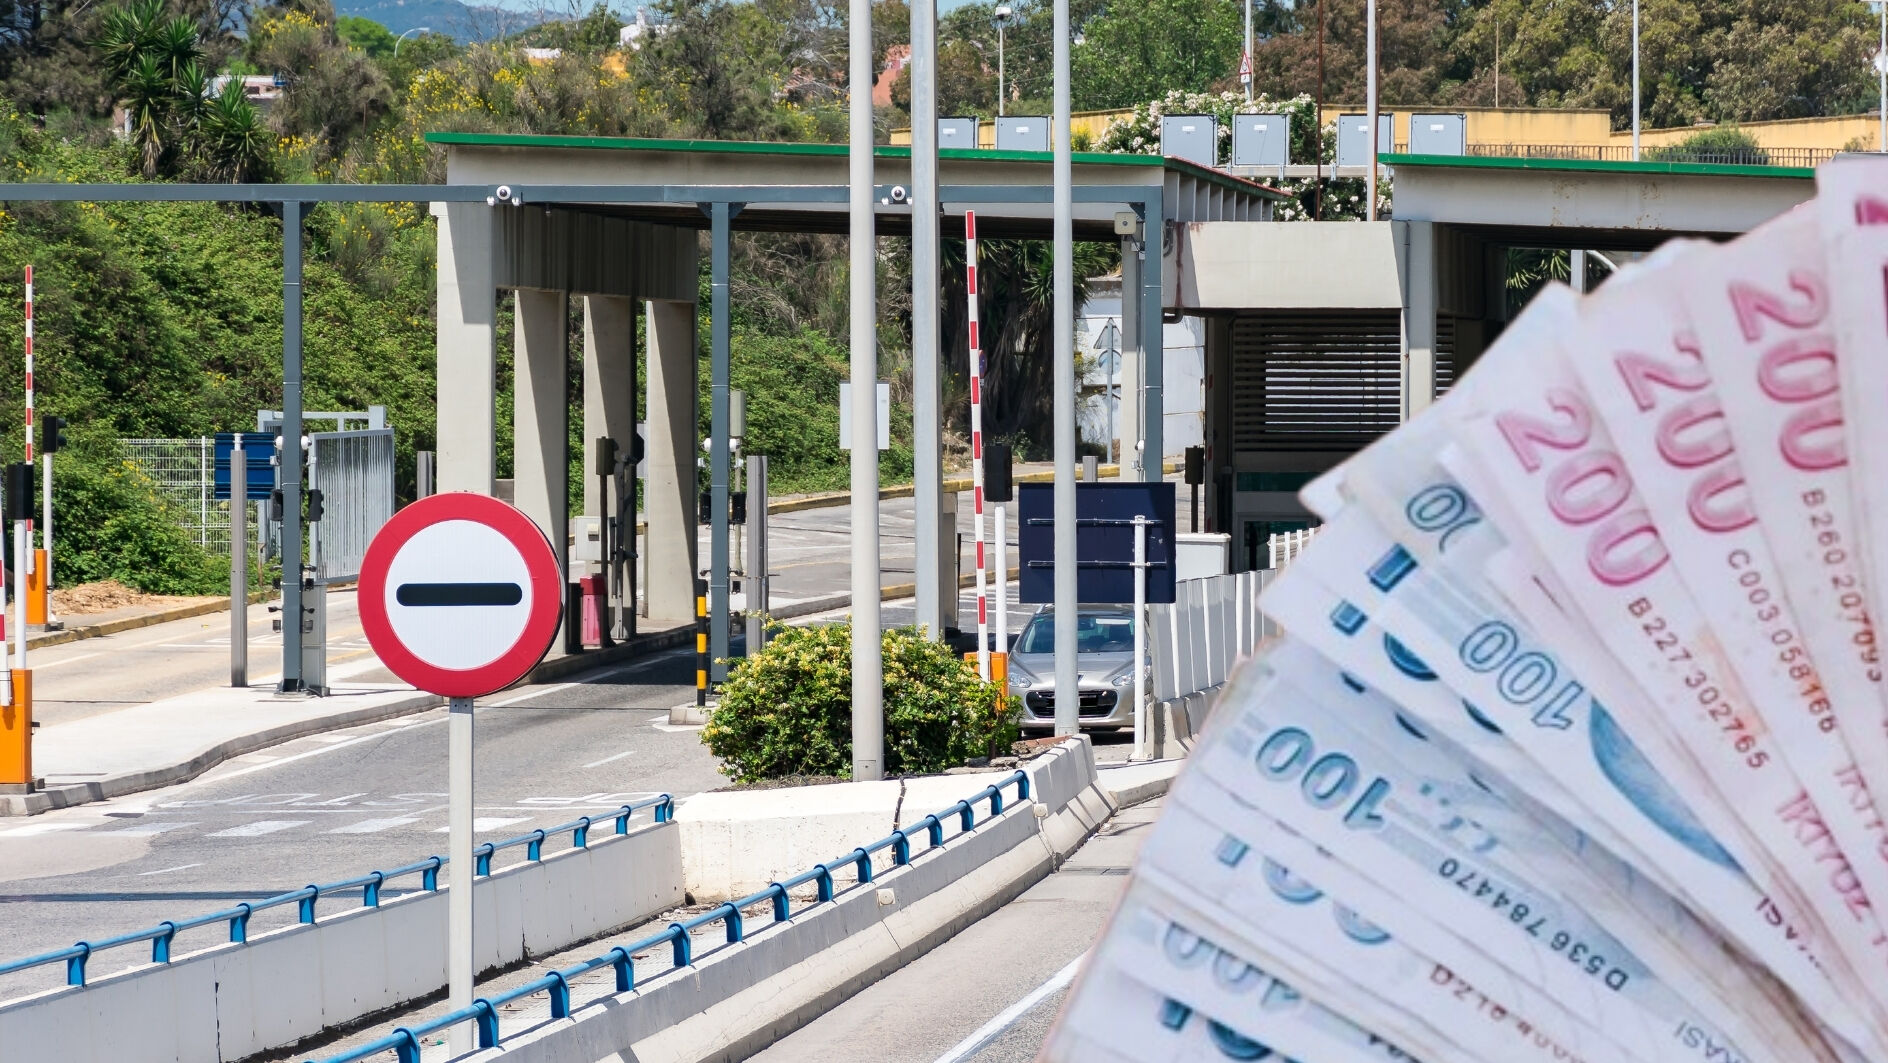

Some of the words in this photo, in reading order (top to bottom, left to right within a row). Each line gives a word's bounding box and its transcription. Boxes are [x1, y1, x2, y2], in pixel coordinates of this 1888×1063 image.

[1728, 269, 1848, 473] 200
[1496, 388, 1671, 588] 200
[1615, 335, 1760, 534] 200
[1802, 488, 1847, 565] B260
[1728, 549, 1781, 623] C003
[1459, 620, 1585, 730] 100
[1627, 597, 1694, 664] B227
[1685, 670, 1771, 769] 302765
[1255, 726, 1392, 831] 100
[1438, 857, 1547, 937] 784470
[1551, 930, 1630, 992] D536
